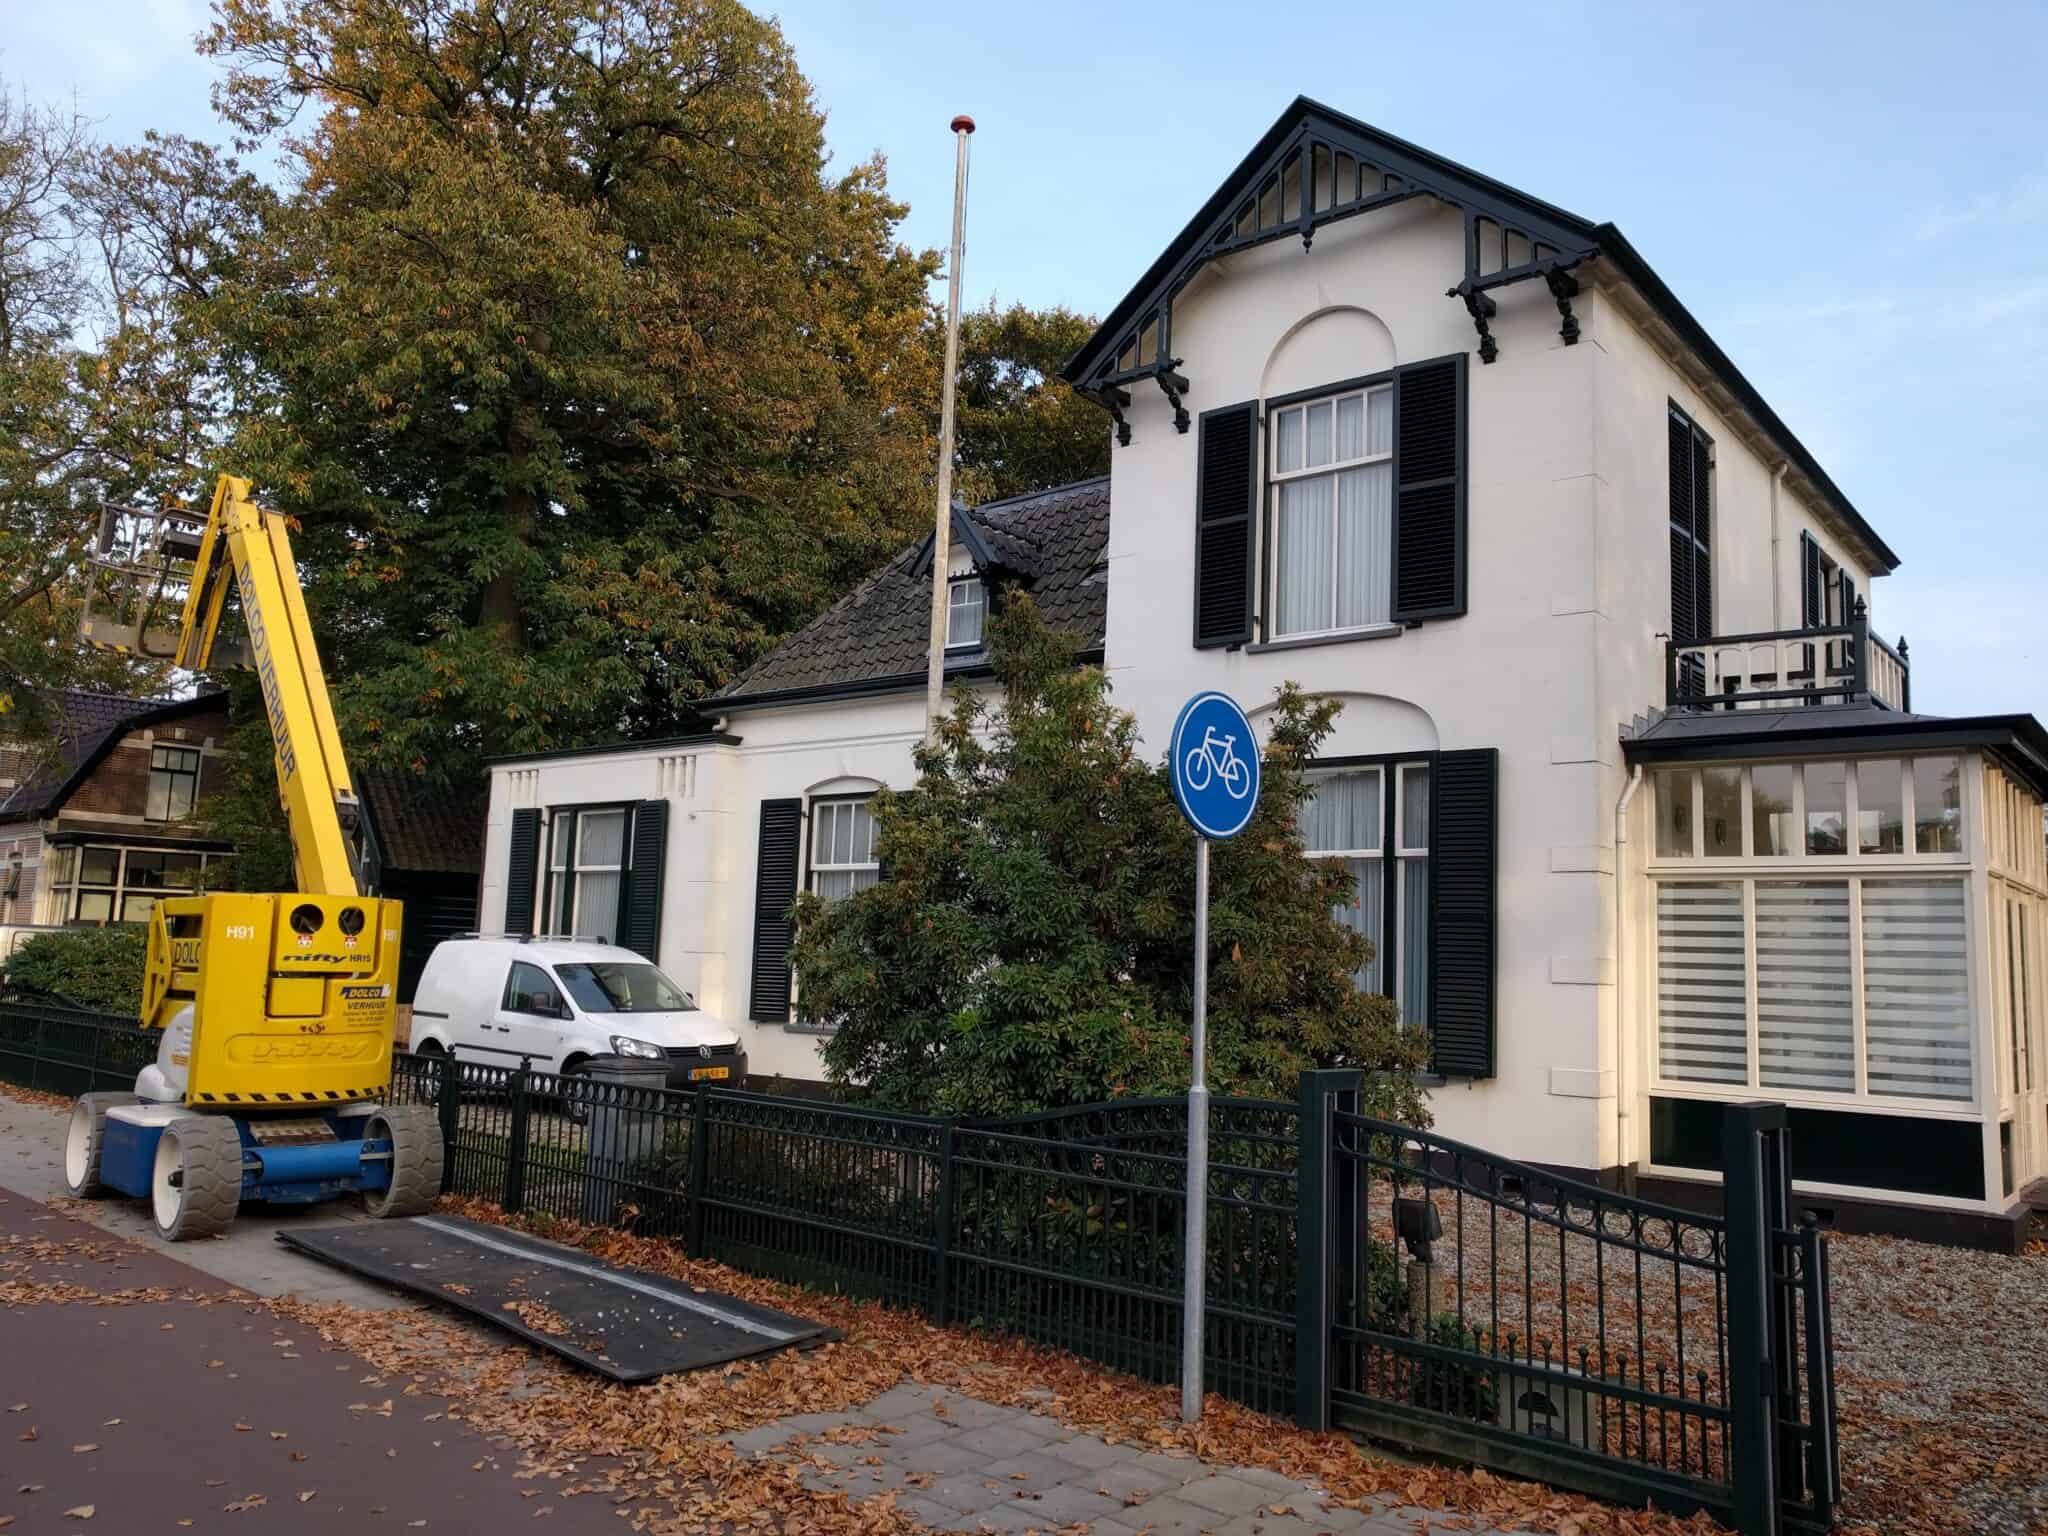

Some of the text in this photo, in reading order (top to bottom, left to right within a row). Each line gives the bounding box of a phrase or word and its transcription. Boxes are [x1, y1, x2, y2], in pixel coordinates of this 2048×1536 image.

[239, 563, 295, 781] DOLCO VERHUUR
[226, 926, 255, 939] H91
[283, 954, 346, 963] nifty
[350, 988, 381, 997] DOLCO
[348, 1001, 385, 1009] VERHUUR
